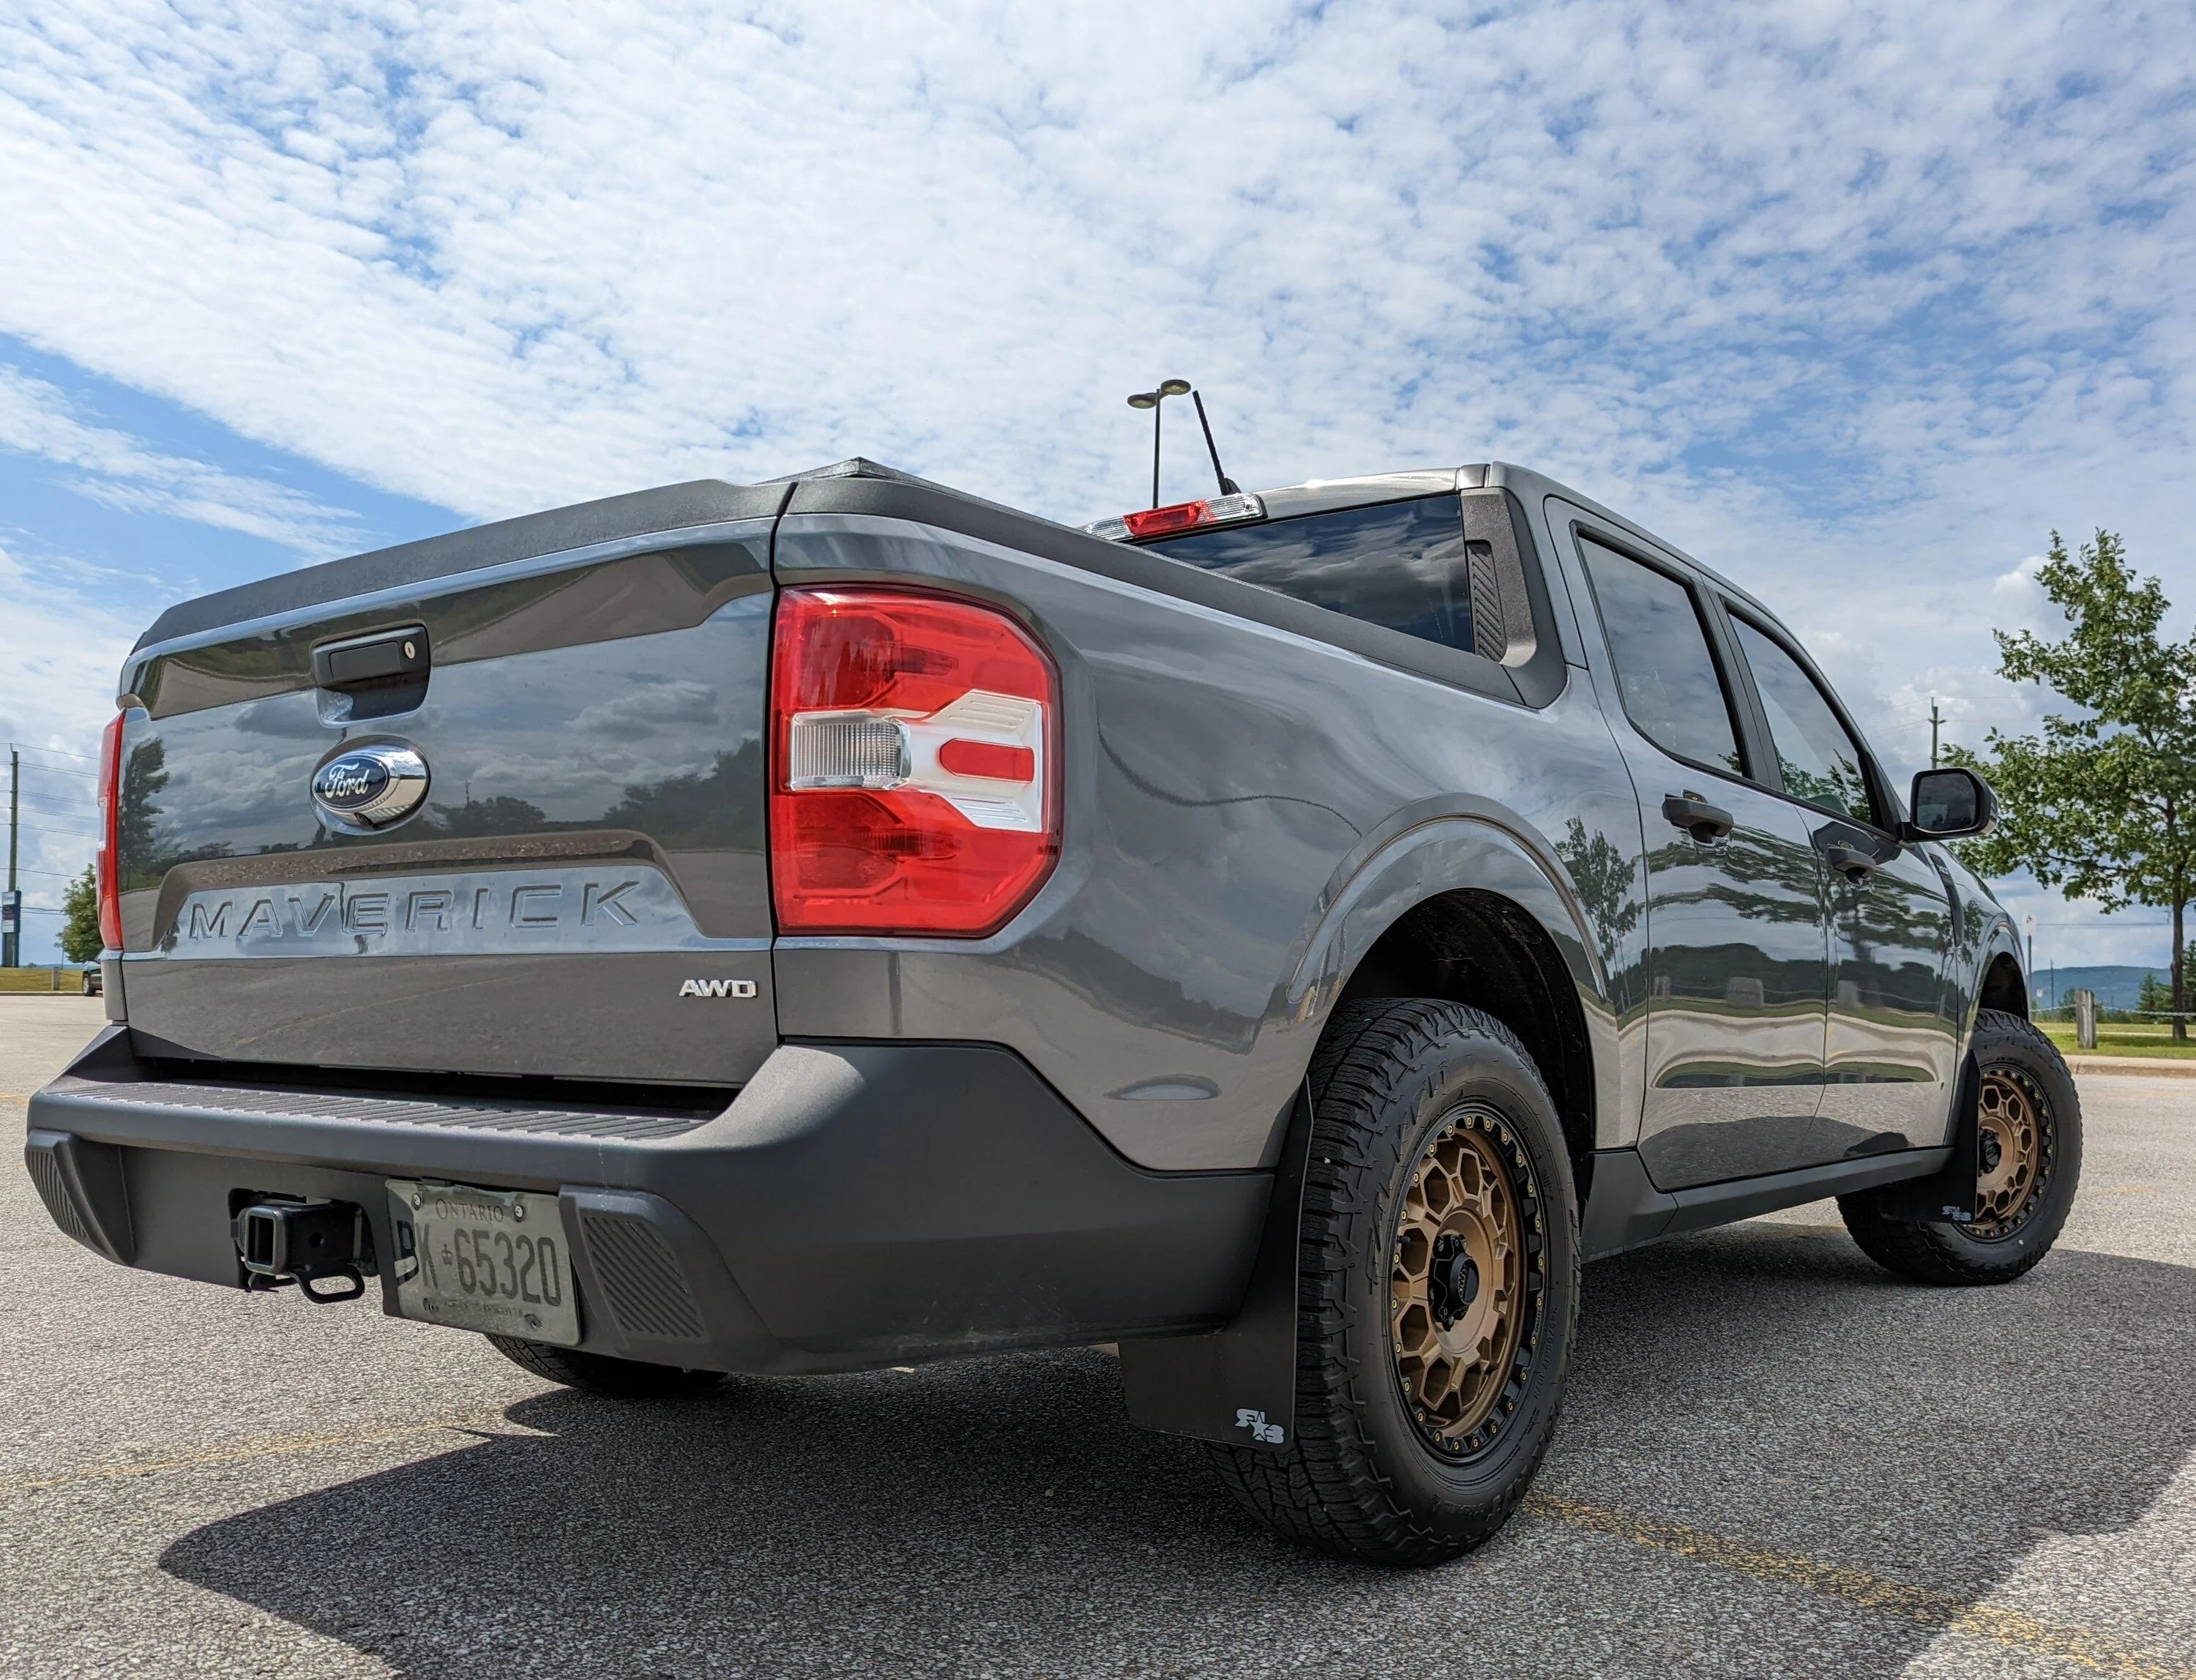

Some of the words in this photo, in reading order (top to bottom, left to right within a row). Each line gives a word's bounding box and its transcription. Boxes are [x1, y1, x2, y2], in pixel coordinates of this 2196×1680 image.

[324, 761, 370, 799] Ford
[188, 880, 640, 941] MAVERICK
[679, 979, 757, 998] AWD
[436, 1198, 504, 1223] ONTARIO
[454, 1228, 561, 1307] 65320
